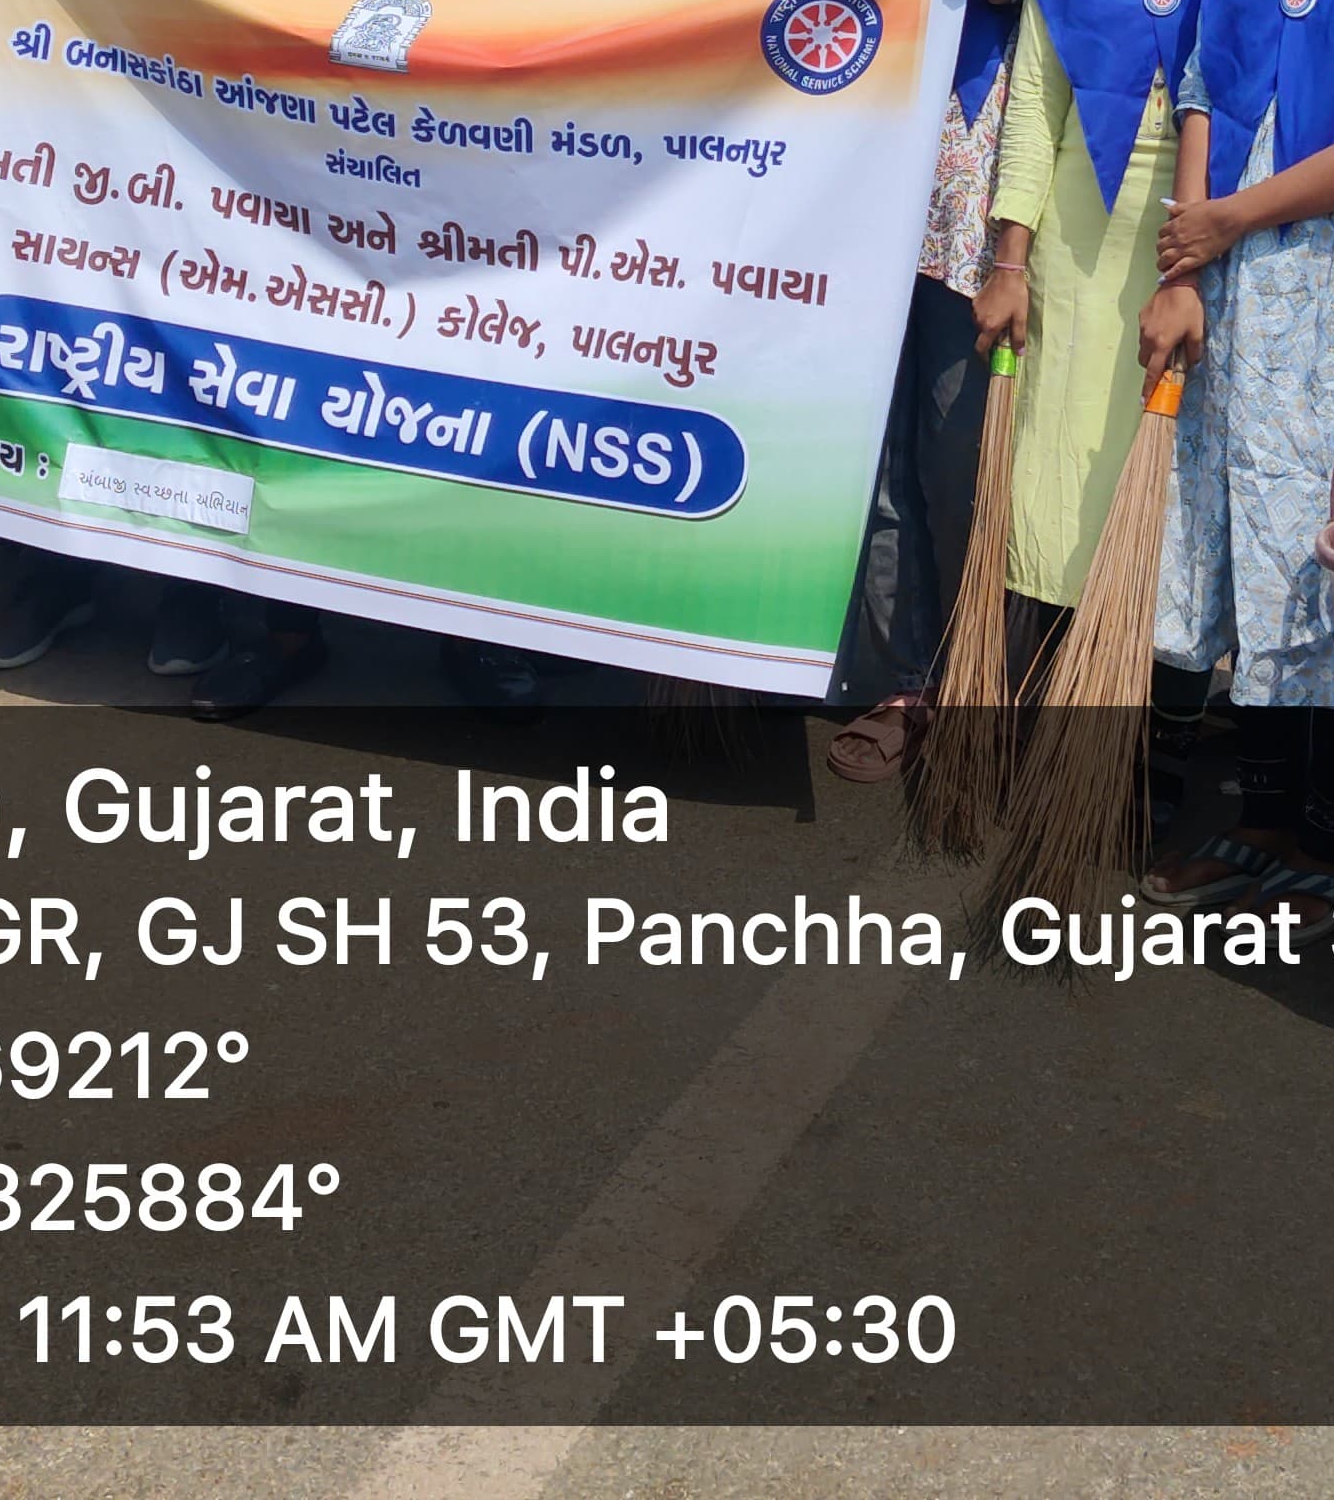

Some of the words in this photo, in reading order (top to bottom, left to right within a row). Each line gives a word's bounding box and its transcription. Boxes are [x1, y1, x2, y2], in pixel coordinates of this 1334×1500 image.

[11, 22, 52, 61] શ્રી
[66, 39, 204, 99] બનાસકાંઠા
[215, 77, 316, 124] આંજણા
[328, 97, 396, 138] પટેલ
[411, 106, 534, 153] કેળવણી
[550, 122, 643, 166] મંડળ,
[663, 133, 787, 178] પાલનપુર
[766, 35, 799, 82] NATIONAL
[801, 75, 843, 90] SERVICE
[845, 36, 877, 79] SCHEME
[73, 161, 184, 211] જી.બી.
[210, 185, 312, 235] પવાયા
[327, 210, 397, 255] અને
[417, 221, 539, 273] શ્રીમતી
[559, 233, 685, 291] પી.એસ.
[711, 259, 828, 307] પવાયા
[325, 147, 421, 188] સંચાલિત
[11, 228, 141, 280] સાયન્સ
[160, 247, 418, 340] (એમ.એસસી.)
[436, 294, 547, 360] કોલેજ,
[571, 323, 719, 389] પાલનપુર
[188, 342, 298, 421] સેવા
[320, 370, 493, 456] યોજના
[517, 409, 703, 504] (NSS)
[195, 491, 250, 518] અભિયાન
